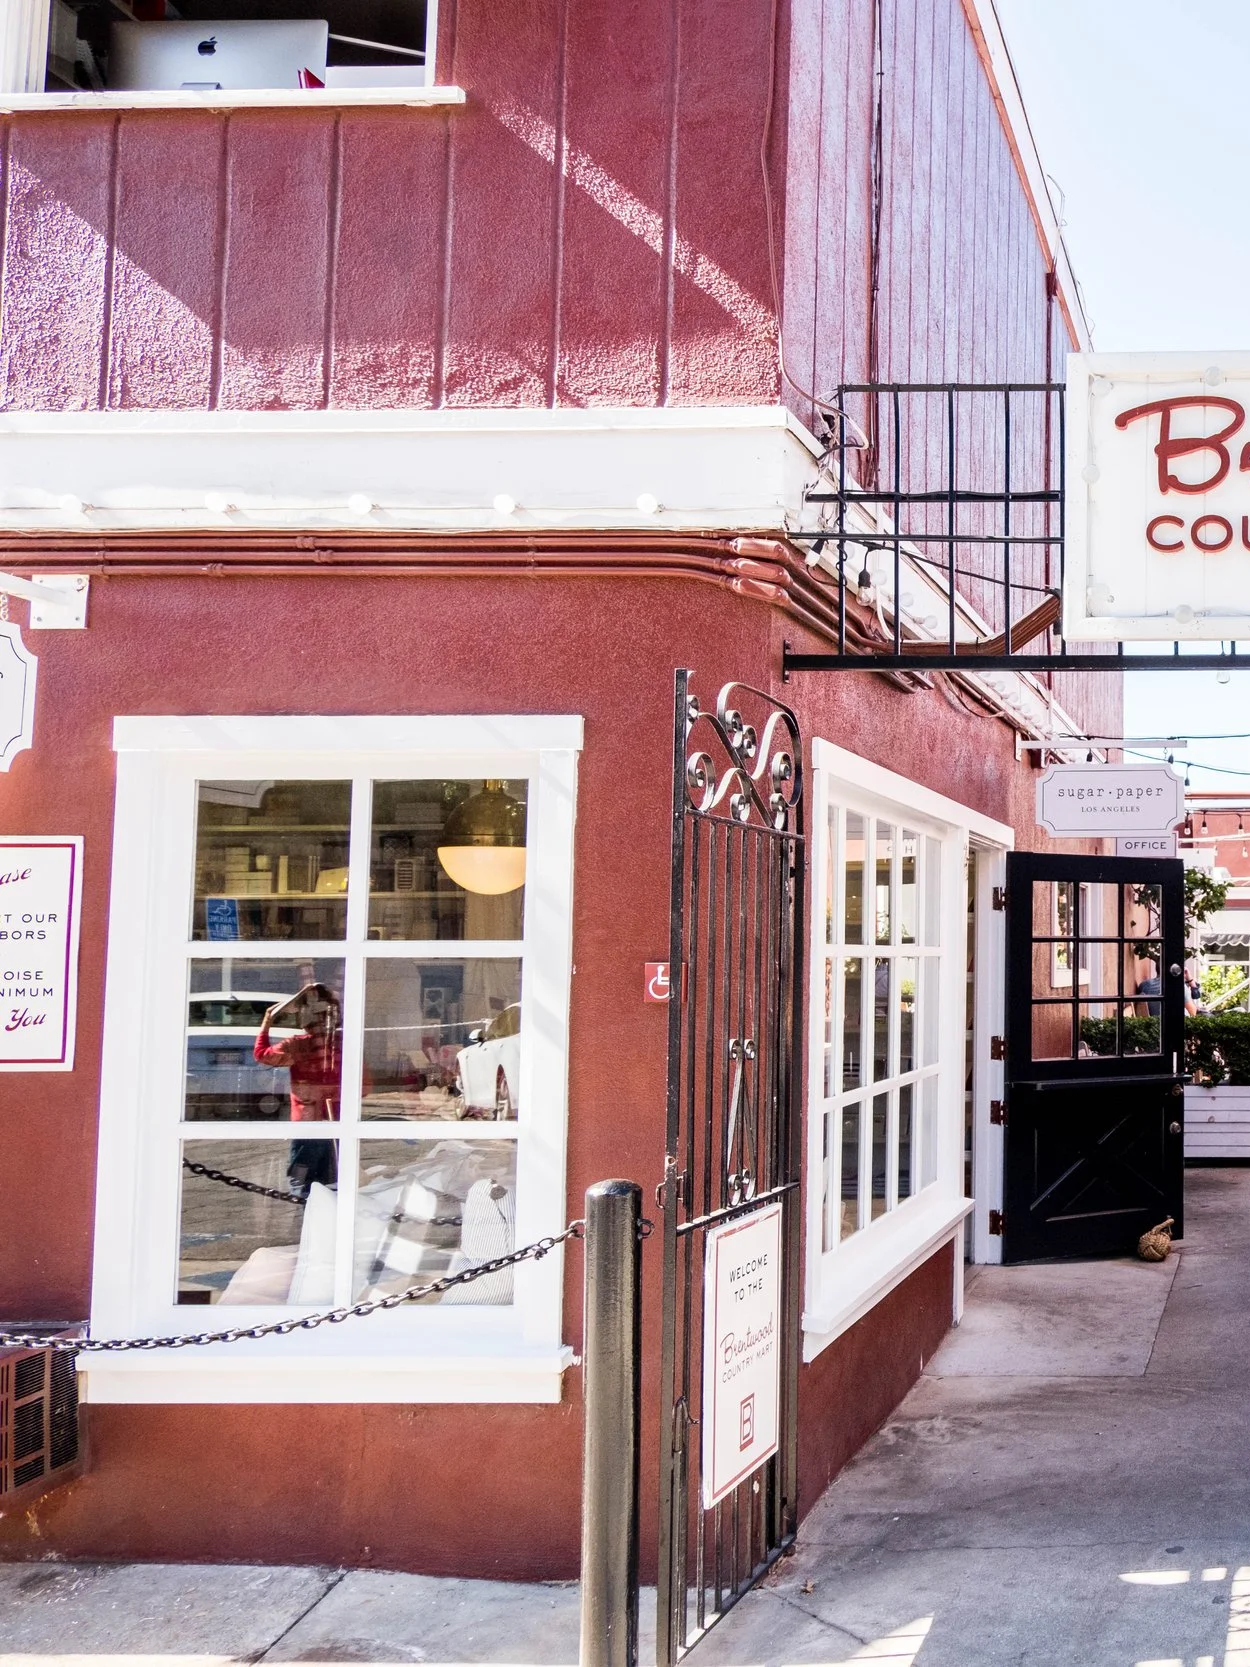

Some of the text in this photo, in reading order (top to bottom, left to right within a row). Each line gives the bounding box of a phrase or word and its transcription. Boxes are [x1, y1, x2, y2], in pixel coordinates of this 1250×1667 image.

[1124, 841, 1168, 850] OFFICE
[20, 913, 58, 924] OUR
[5, 1007, 47, 1031] You
[729, 1253, 768, 1283] WELCOME
[734, 1277, 764, 1303] TO THE
[720, 1311, 774, 1364] Brentwood
[722, 1340, 773, 1384] COUNTRY MART
